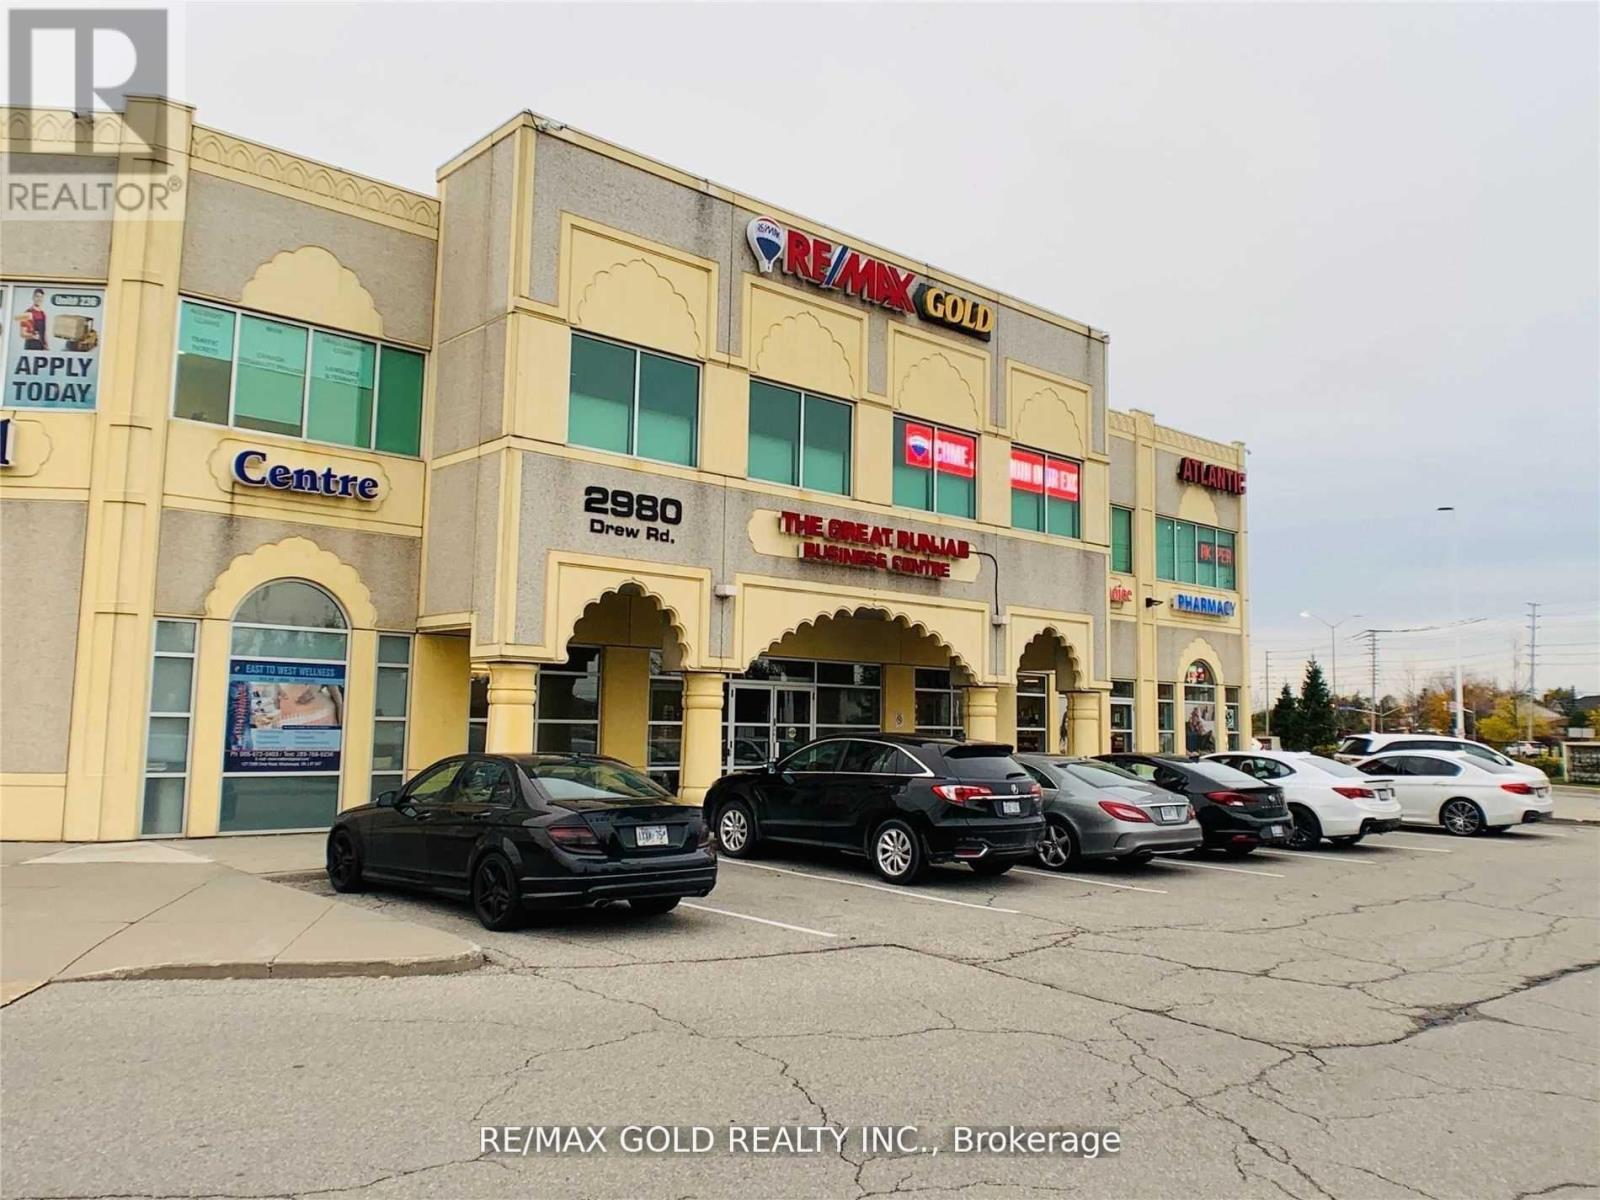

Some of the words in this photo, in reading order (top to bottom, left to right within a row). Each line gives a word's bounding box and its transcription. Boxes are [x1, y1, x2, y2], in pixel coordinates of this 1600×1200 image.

[785, 229, 916, 314] RE/MAX
[926, 287, 993, 333] GOLD
[14, 355, 93, 377] APPLY
[12, 381, 92, 403] TODAY
[233, 450, 379, 499] Centre
[1179, 457, 1246, 495] ATLANTIC
[584, 486, 682, 525] 2980
[590, 518, 640, 539] Drew
[646, 526, 675, 544] Rd.
[780, 511, 823, 537] THE
[828, 519, 894, 547] GREAT
[897, 530, 970, 559] PUNJAB
[802, 542, 888, 569] BUSINESS
[891, 555, 951, 578] CENTRE
[1177, 594, 1237, 617] PHARMACY
[246, 664, 264, 674] EAST
[266, 665, 276, 674] TO
[277, 666, 297, 676] WEST
[300, 667, 336, 677] WELLNESS
